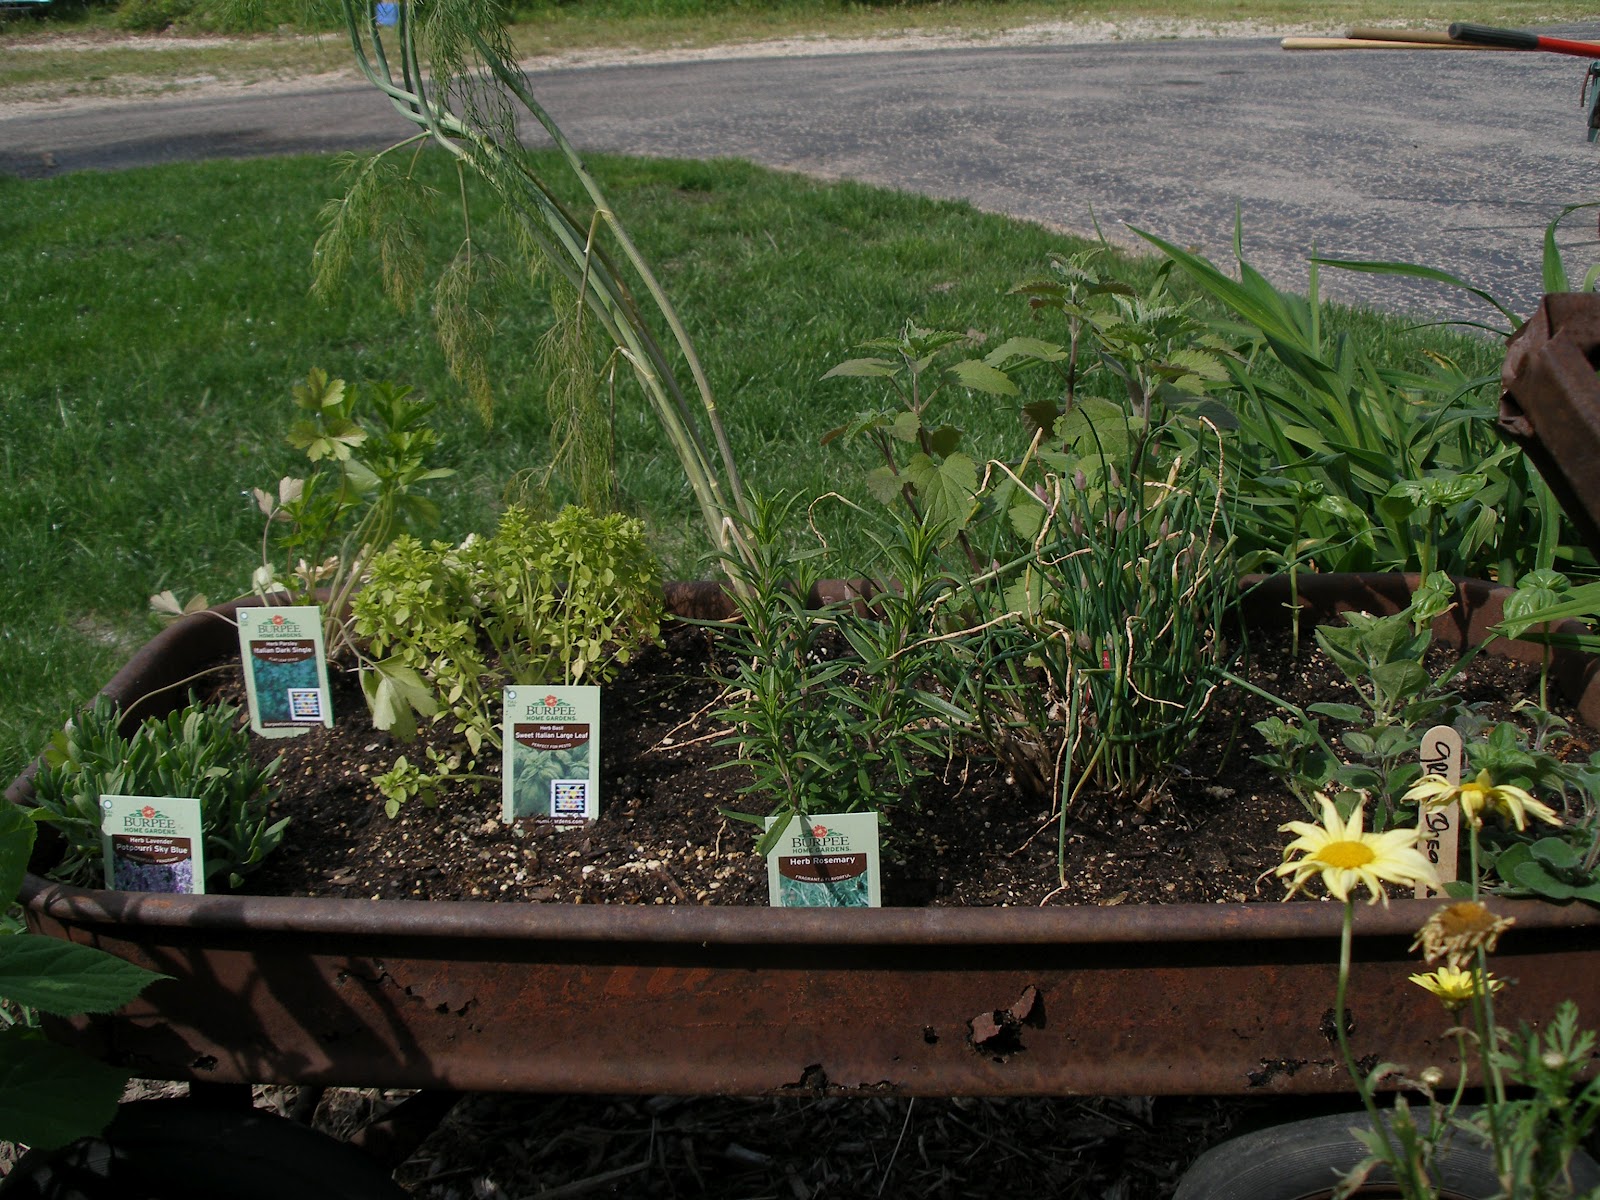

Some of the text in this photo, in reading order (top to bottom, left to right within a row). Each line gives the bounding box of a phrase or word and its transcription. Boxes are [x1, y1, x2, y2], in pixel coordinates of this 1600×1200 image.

[258, 625, 301, 633] BURPEE
[526, 706, 576, 715] BURPEE
[124, 817, 175, 828] BURPEE
[792, 837, 850, 847] BURPEE
[116, 844, 152, 852] Potpourri
[154, 845, 169, 854] Sky
[813, 856, 856, 865] Rosemary
